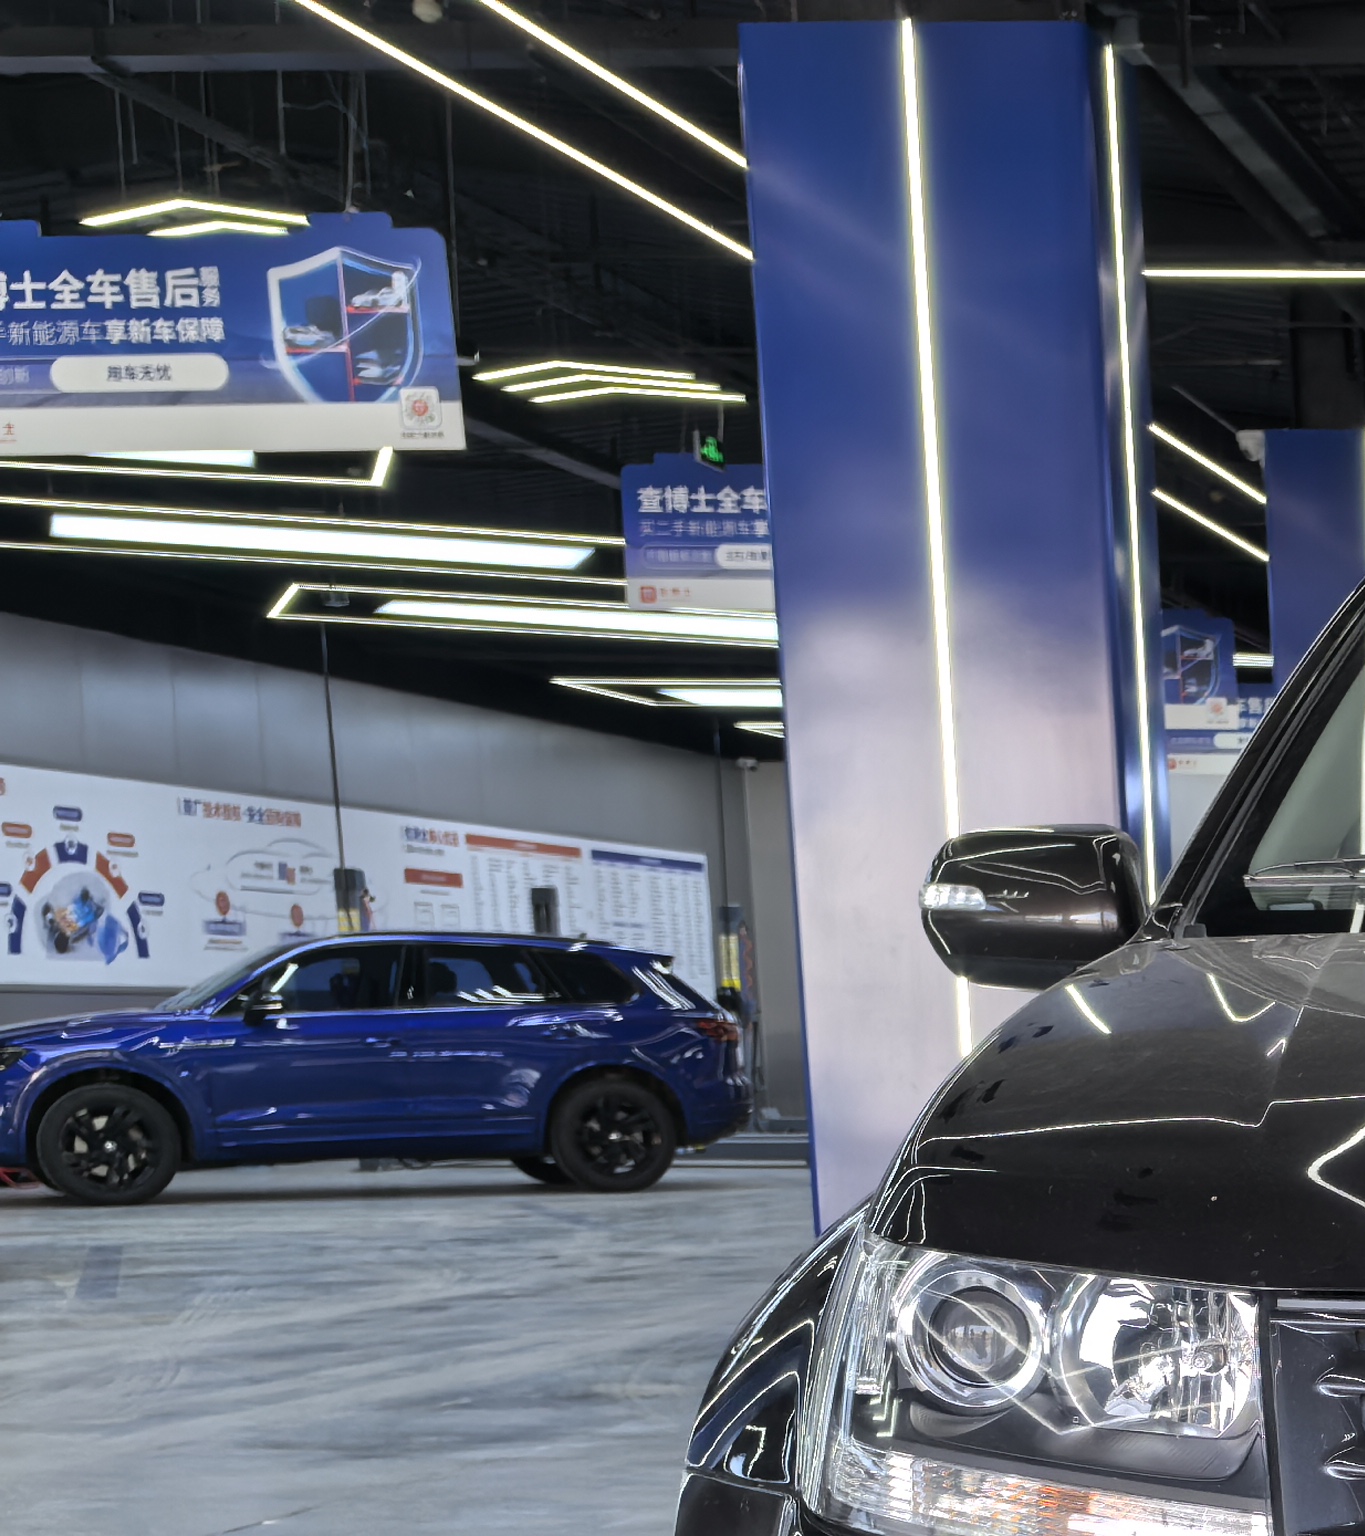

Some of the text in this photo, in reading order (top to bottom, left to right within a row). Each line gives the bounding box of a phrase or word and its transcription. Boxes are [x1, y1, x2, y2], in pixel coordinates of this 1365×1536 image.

[0, 266, 221, 310] 士全车售后服务
